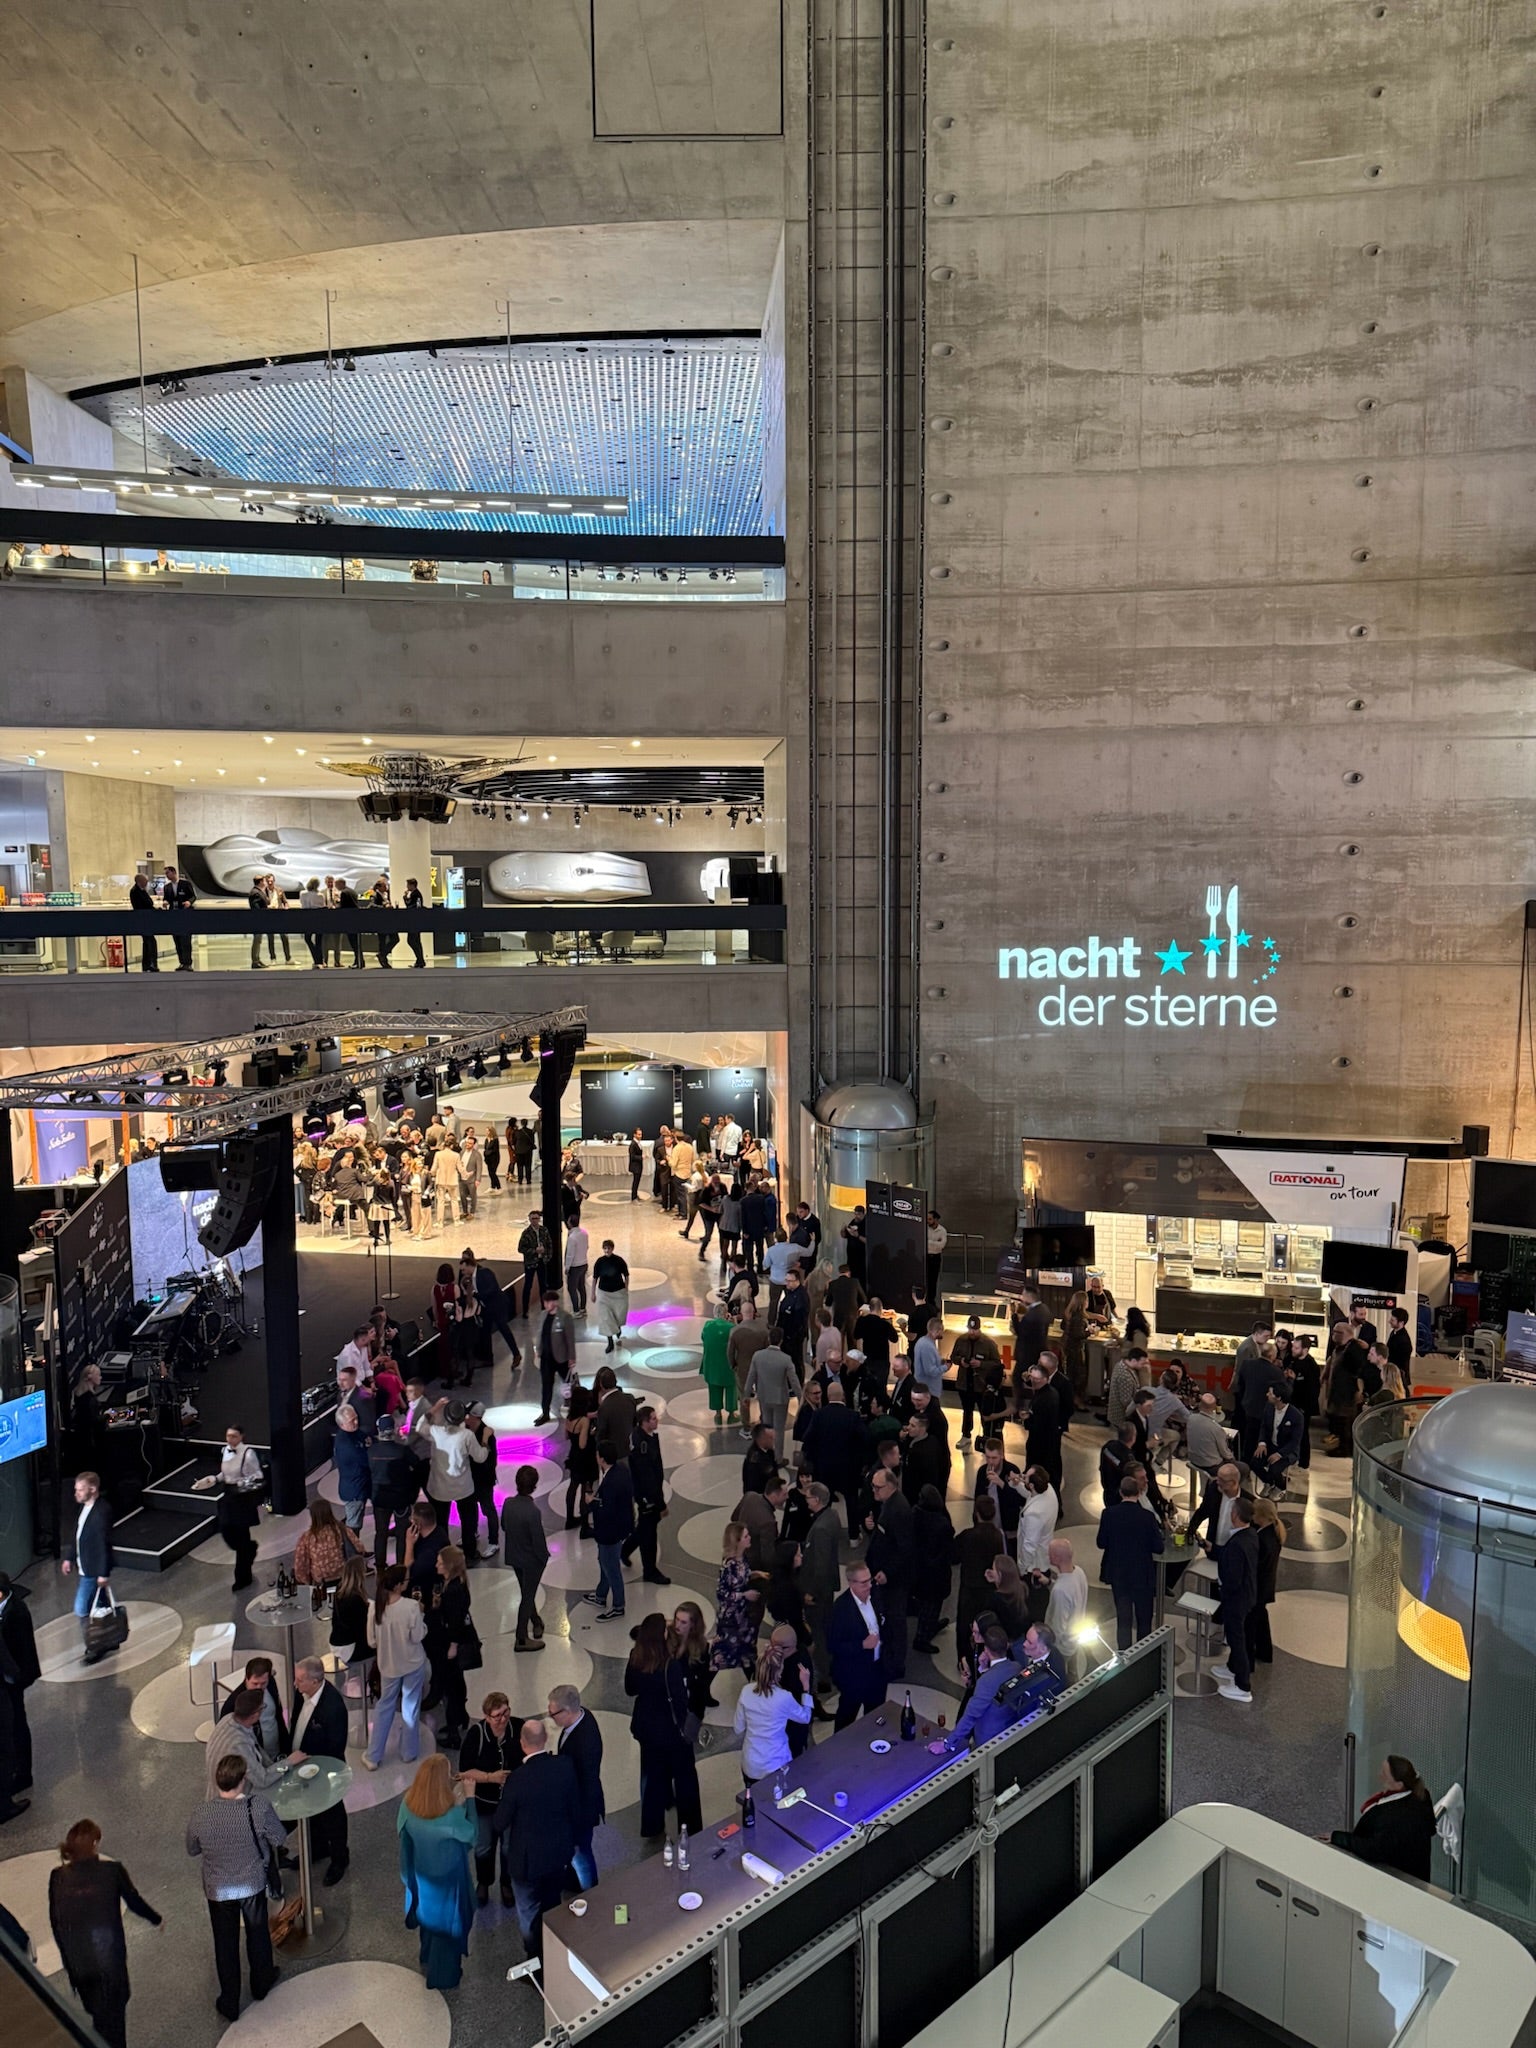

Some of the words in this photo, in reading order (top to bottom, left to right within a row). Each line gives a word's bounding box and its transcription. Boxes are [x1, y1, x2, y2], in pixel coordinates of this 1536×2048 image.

[998, 936, 1141, 978] nacht
[1038, 985, 1116, 1026] der
[1124, 985, 1278, 1027] sterne
[1273, 1174, 1341, 1185] RATIONAL
[1330, 1192, 1347, 1200] on
[1348, 1186, 1380, 1199] tour
